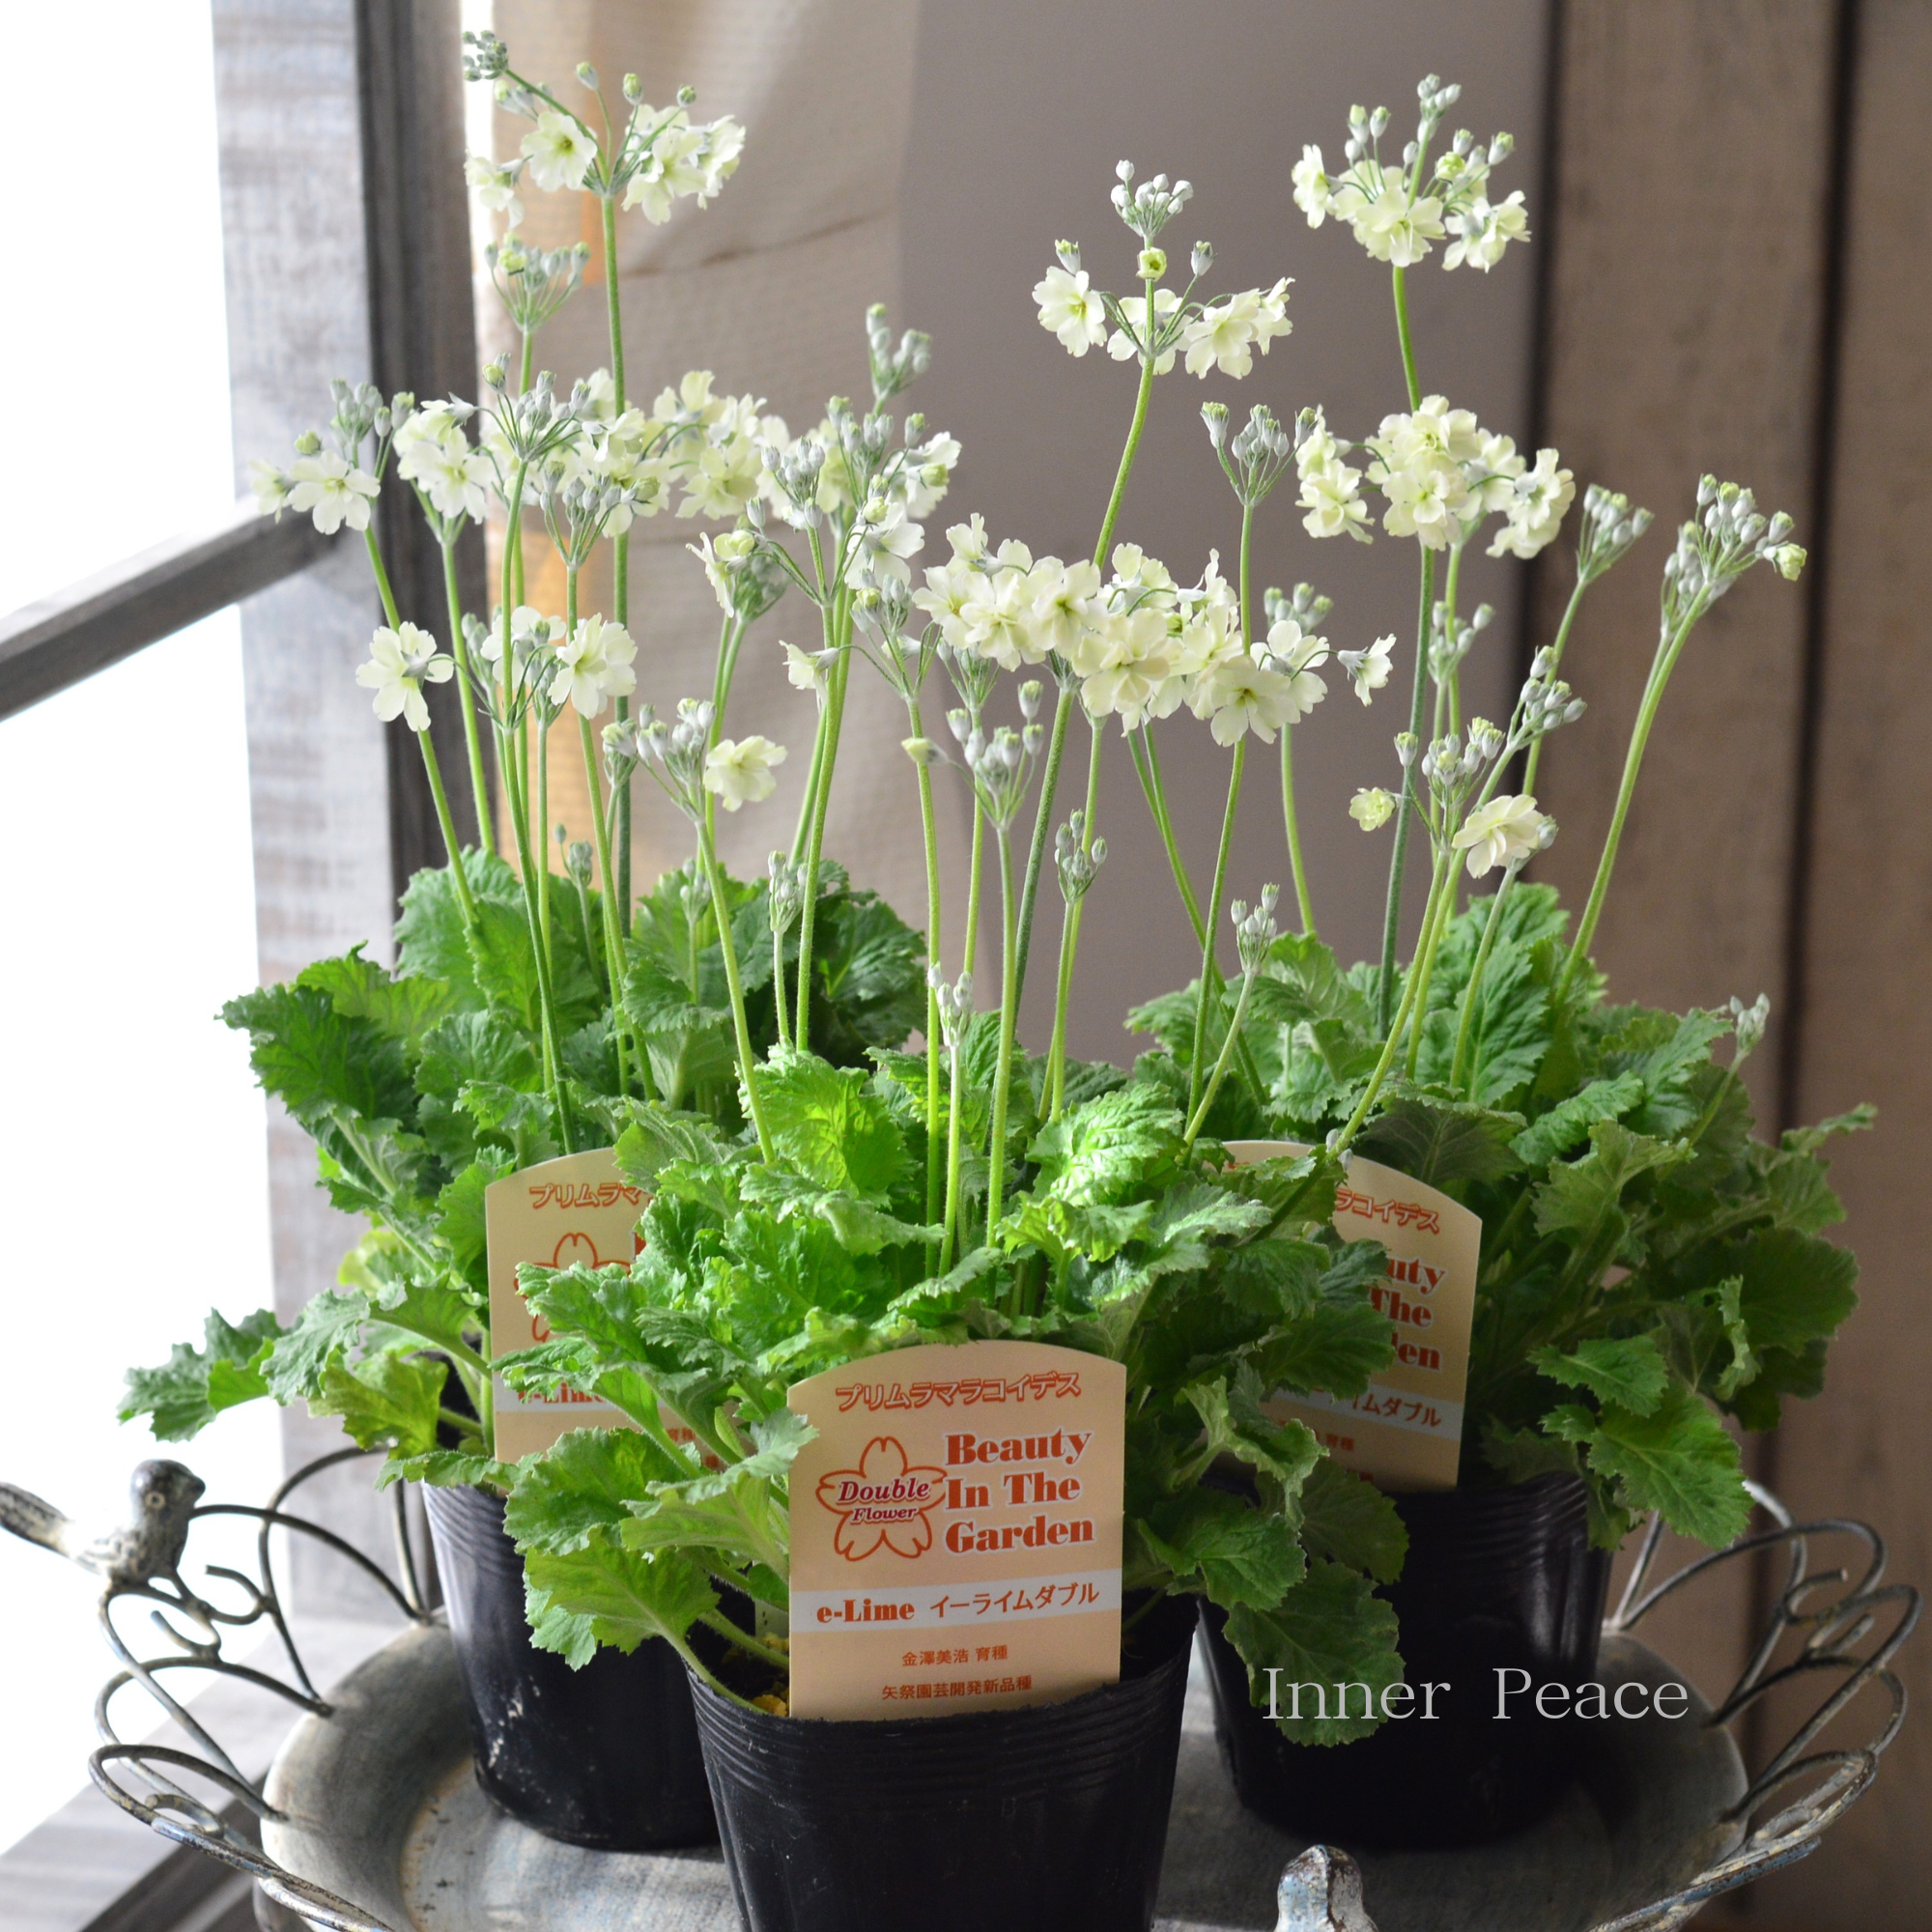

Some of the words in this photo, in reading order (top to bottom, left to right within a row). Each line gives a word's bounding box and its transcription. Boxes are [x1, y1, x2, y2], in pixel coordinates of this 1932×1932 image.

[529, 1182, 653, 1209] プリムラマ
[1336, 1187, 1439, 1235] ラコイデス
[1386, 1259, 1446, 1294] uty
[1365, 1285, 1432, 1327] The
[836, 1370, 1081, 1412] プリムラマラコイデス
[1353, 1393, 1441, 1427] ムダブル
[945, 1428, 1093, 1465] Beauty
[837, 1477, 930, 1504] Double
[945, 1478, 990, 1510] In
[1003, 1471, 1081, 1505] The
[851, 1507, 918, 1523] Flower
[945, 1515, 1094, 1554] Garden
[816, 1598, 915, 1624] e-Lime
[930, 1582, 1100, 1618] イーライムダブル
[976, 1644, 1009, 1662] 育種
[882, 1674, 1033, 1700] 矢祭園芸開発新品種
